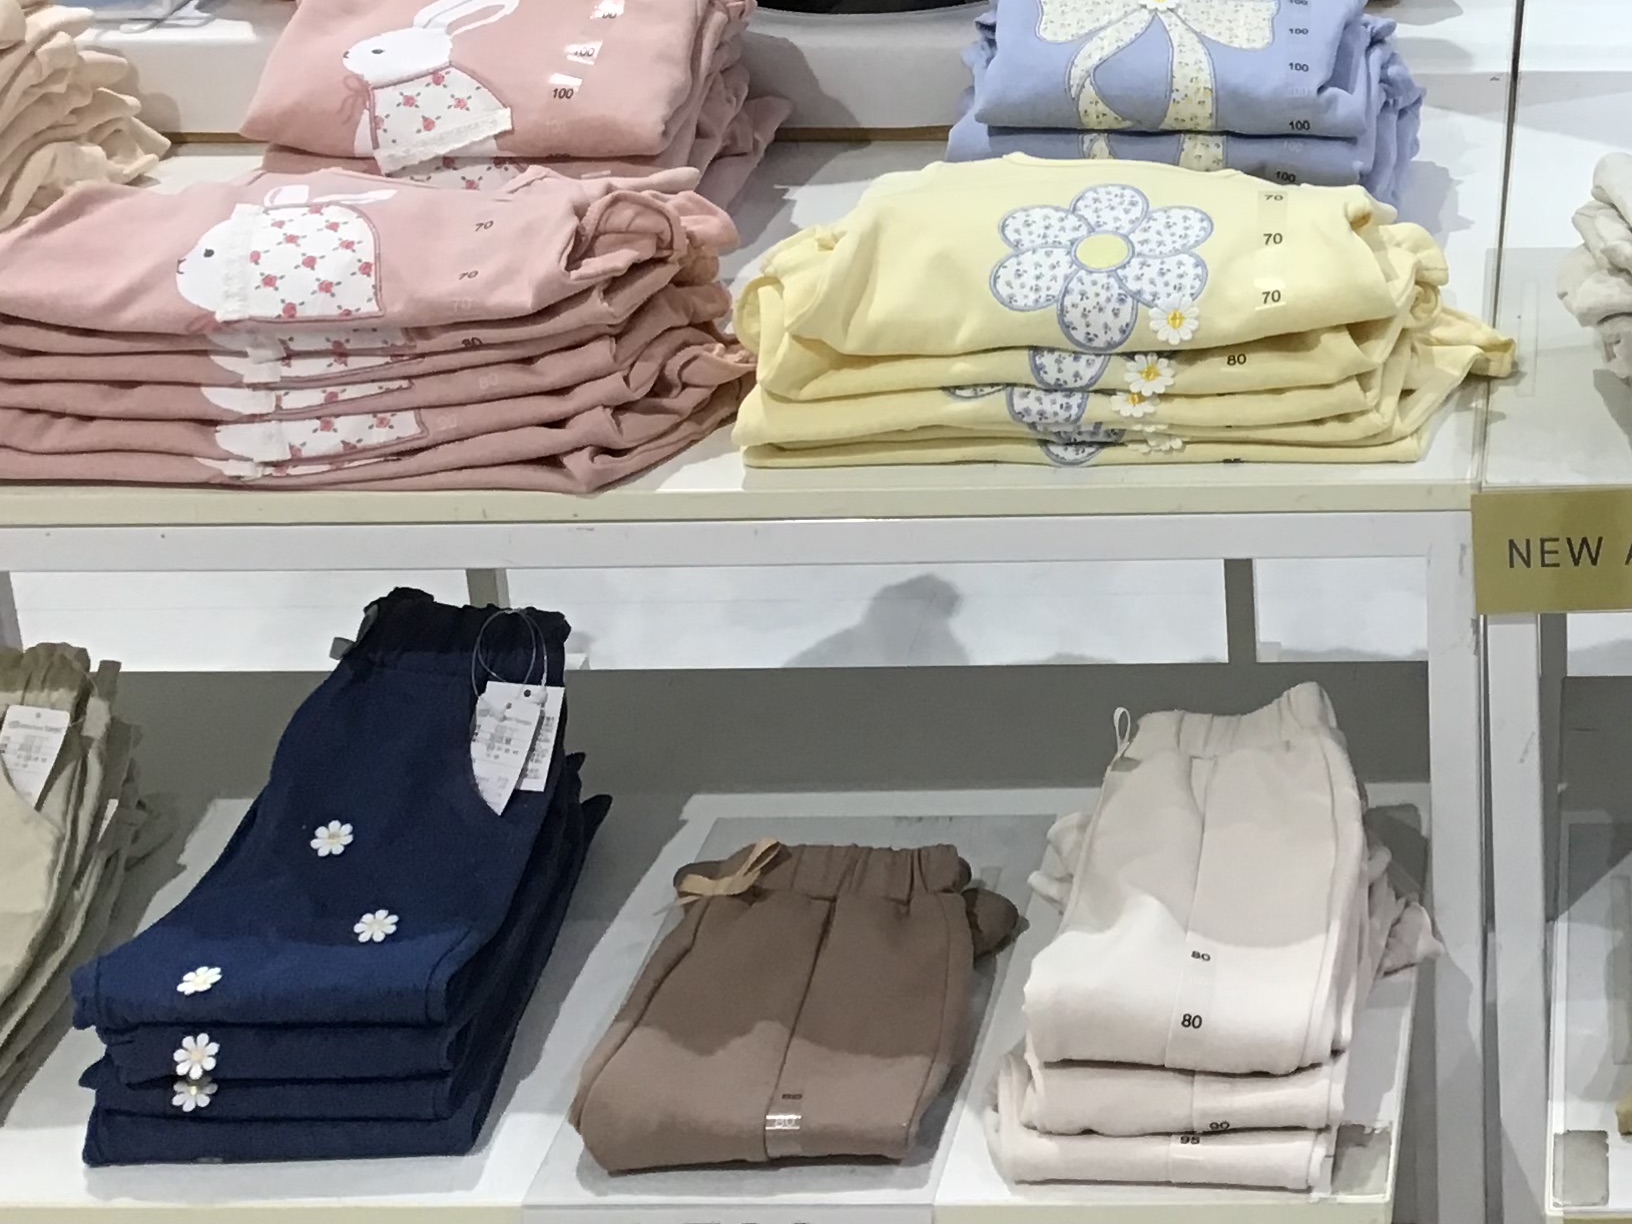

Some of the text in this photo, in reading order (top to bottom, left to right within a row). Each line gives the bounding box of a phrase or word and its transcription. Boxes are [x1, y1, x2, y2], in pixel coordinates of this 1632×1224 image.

[1289, 62, 1309, 73] 100
[553, 88, 574, 100] 100
[1289, 120, 1310, 131] 100
[1276, 170, 1296, 184] 100
[1264, 193, 1284, 202] 70
[475, 220, 494, 232] 70
[1263, 232, 1284, 246] 70
[458, 270, 479, 280] 70
[1261, 289, 1282, 305] 70
[1226, 353, 1247, 367] 80
[1508, 537, 1603, 568] NEW
[1191, 949, 1211, 963] 80
[1181, 1012, 1203, 1030] 80
